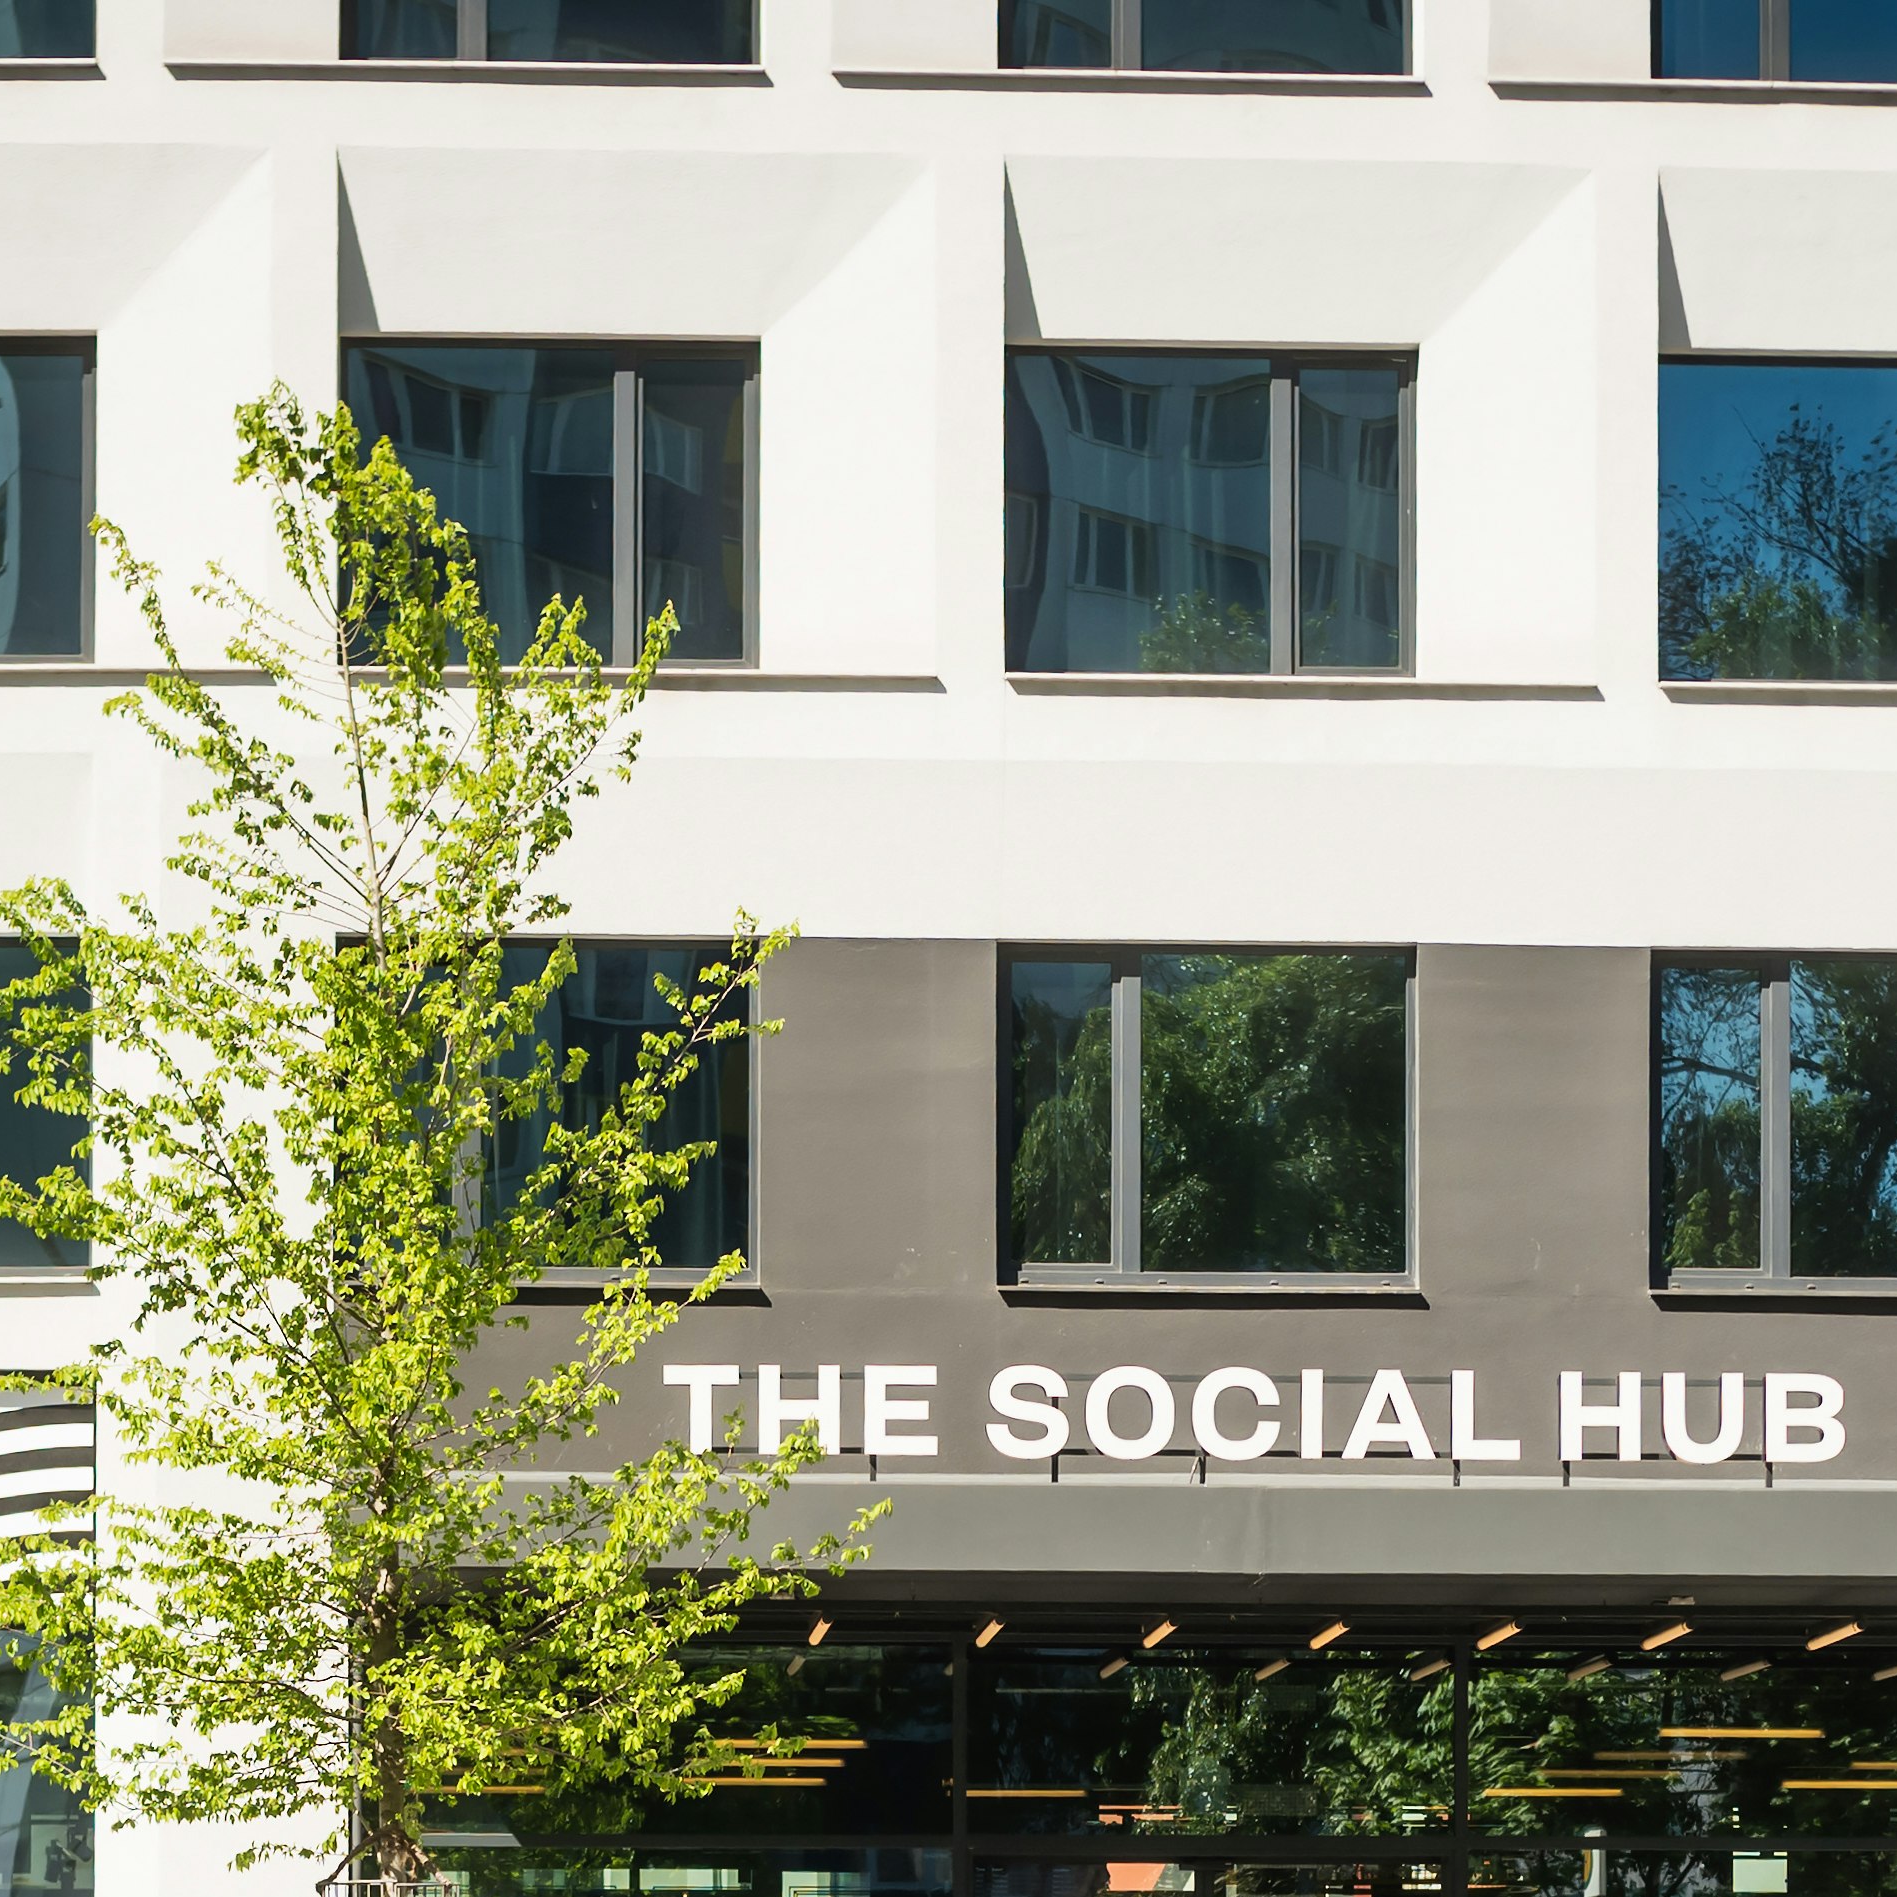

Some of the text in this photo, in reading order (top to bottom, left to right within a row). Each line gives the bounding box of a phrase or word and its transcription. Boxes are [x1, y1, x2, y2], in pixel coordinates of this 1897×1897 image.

[662, 1363, 1847, 1464] THE SOCIAL HUB
